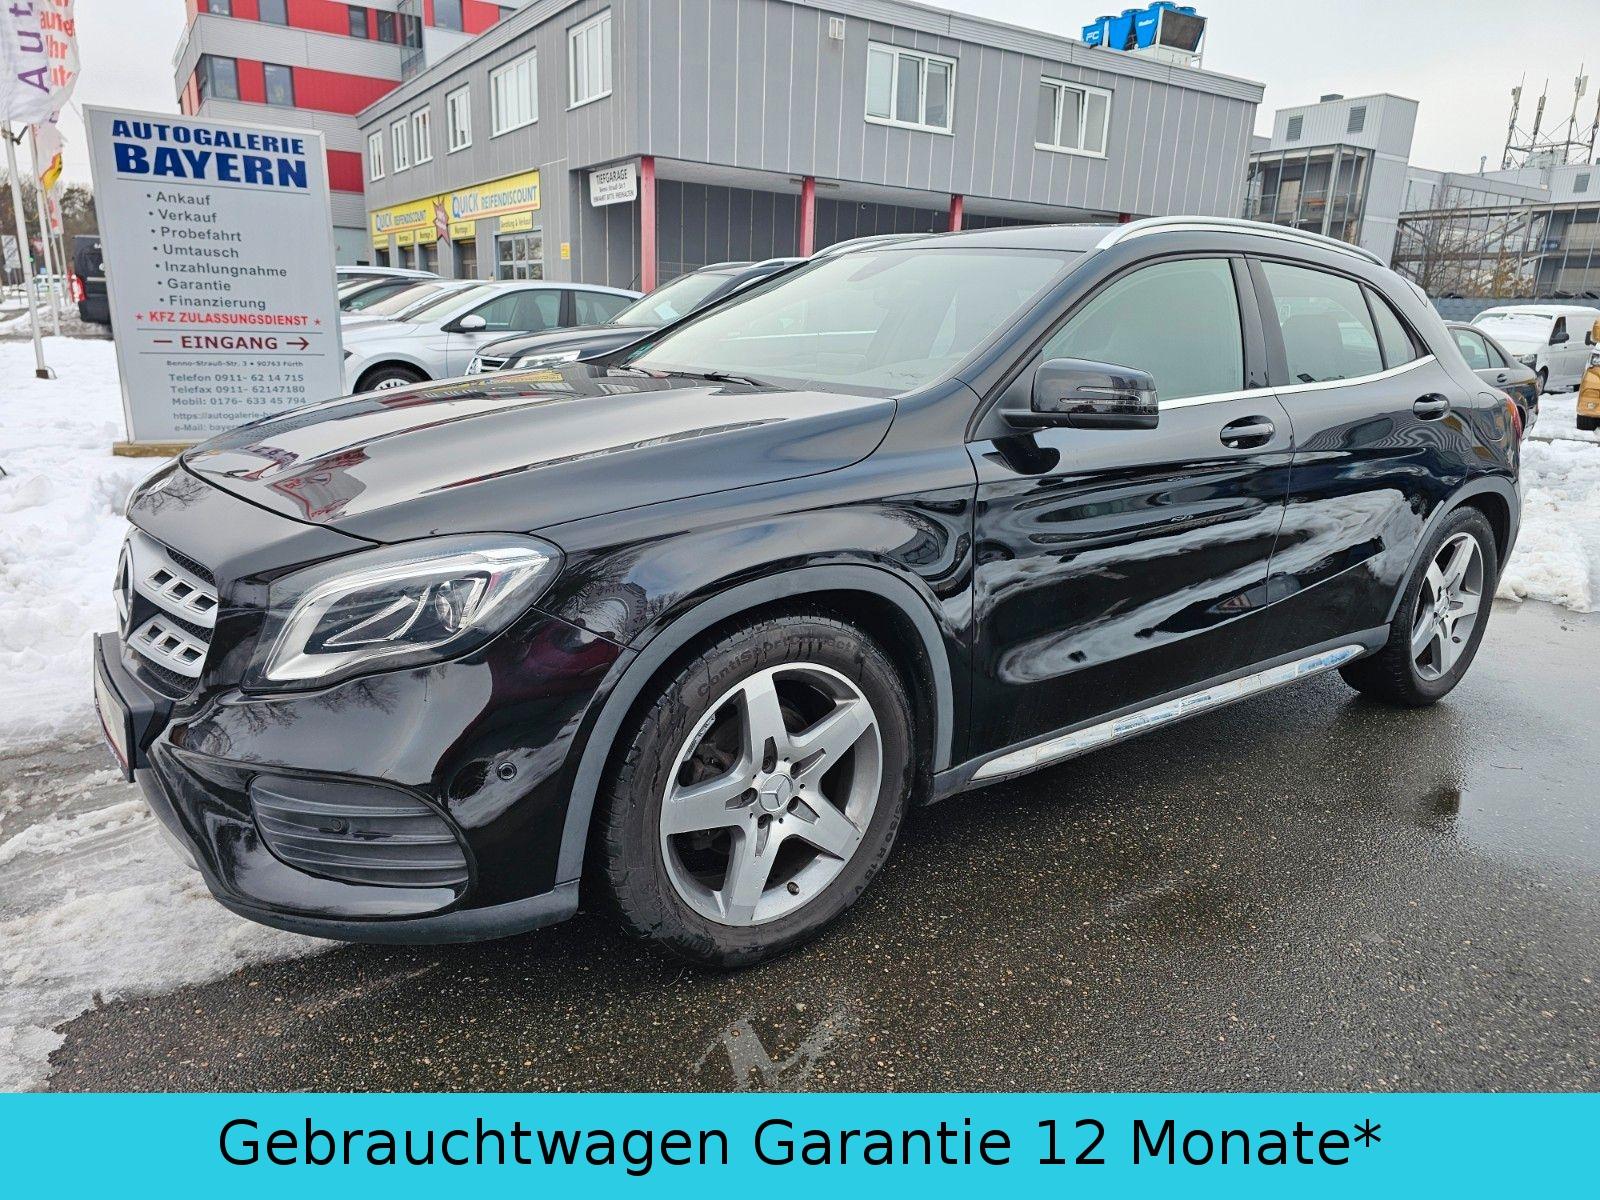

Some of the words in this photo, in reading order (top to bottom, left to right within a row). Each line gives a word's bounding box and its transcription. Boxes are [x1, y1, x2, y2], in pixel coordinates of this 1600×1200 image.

[112, 120, 305, 156] AUTOGALERIE
[114, 142, 308, 189] BAYERN
[596, 168, 628, 185] TIEFGARAGE
[156, 191, 211, 206] Ankauf
[451, 191, 479, 219] QUICK
[480, 185, 537, 211] REIFENDISCOUNT
[158, 209, 217, 223] Verkauf
[376, 211, 393, 232] QUICK
[161, 226, 242, 242] Probefahrt
[163, 243, 240, 258] Umtausch
[165, 261, 287, 278] Inzahlungnahme
[167, 278, 232, 291] Garantie
[169, 295, 266, 311] Finanzierung
[149, 311, 176, 323] KFZ
[179, 312, 308, 326] ZULASSUNGSDIENST
[181, 335, 278, 350] EINGANG
[169, 373, 211, 382] Telefon
[215, 373, 247, 382] 0911-
[251, 374, 264, 382] 62
[268, 374, 281, 382] 14
[285, 374, 304, 382] 715
[170, 385, 212, 394] Telefax
[215, 385, 248, 394] 0911-
[252, 386, 306, 394] 62147180
[172, 397, 206, 406] Mobil:
[210, 397, 243, 406] 0176-
[246, 397, 265, 406] 633
[270, 397, 283, 406] 45
[287, 397, 307, 406] 794
